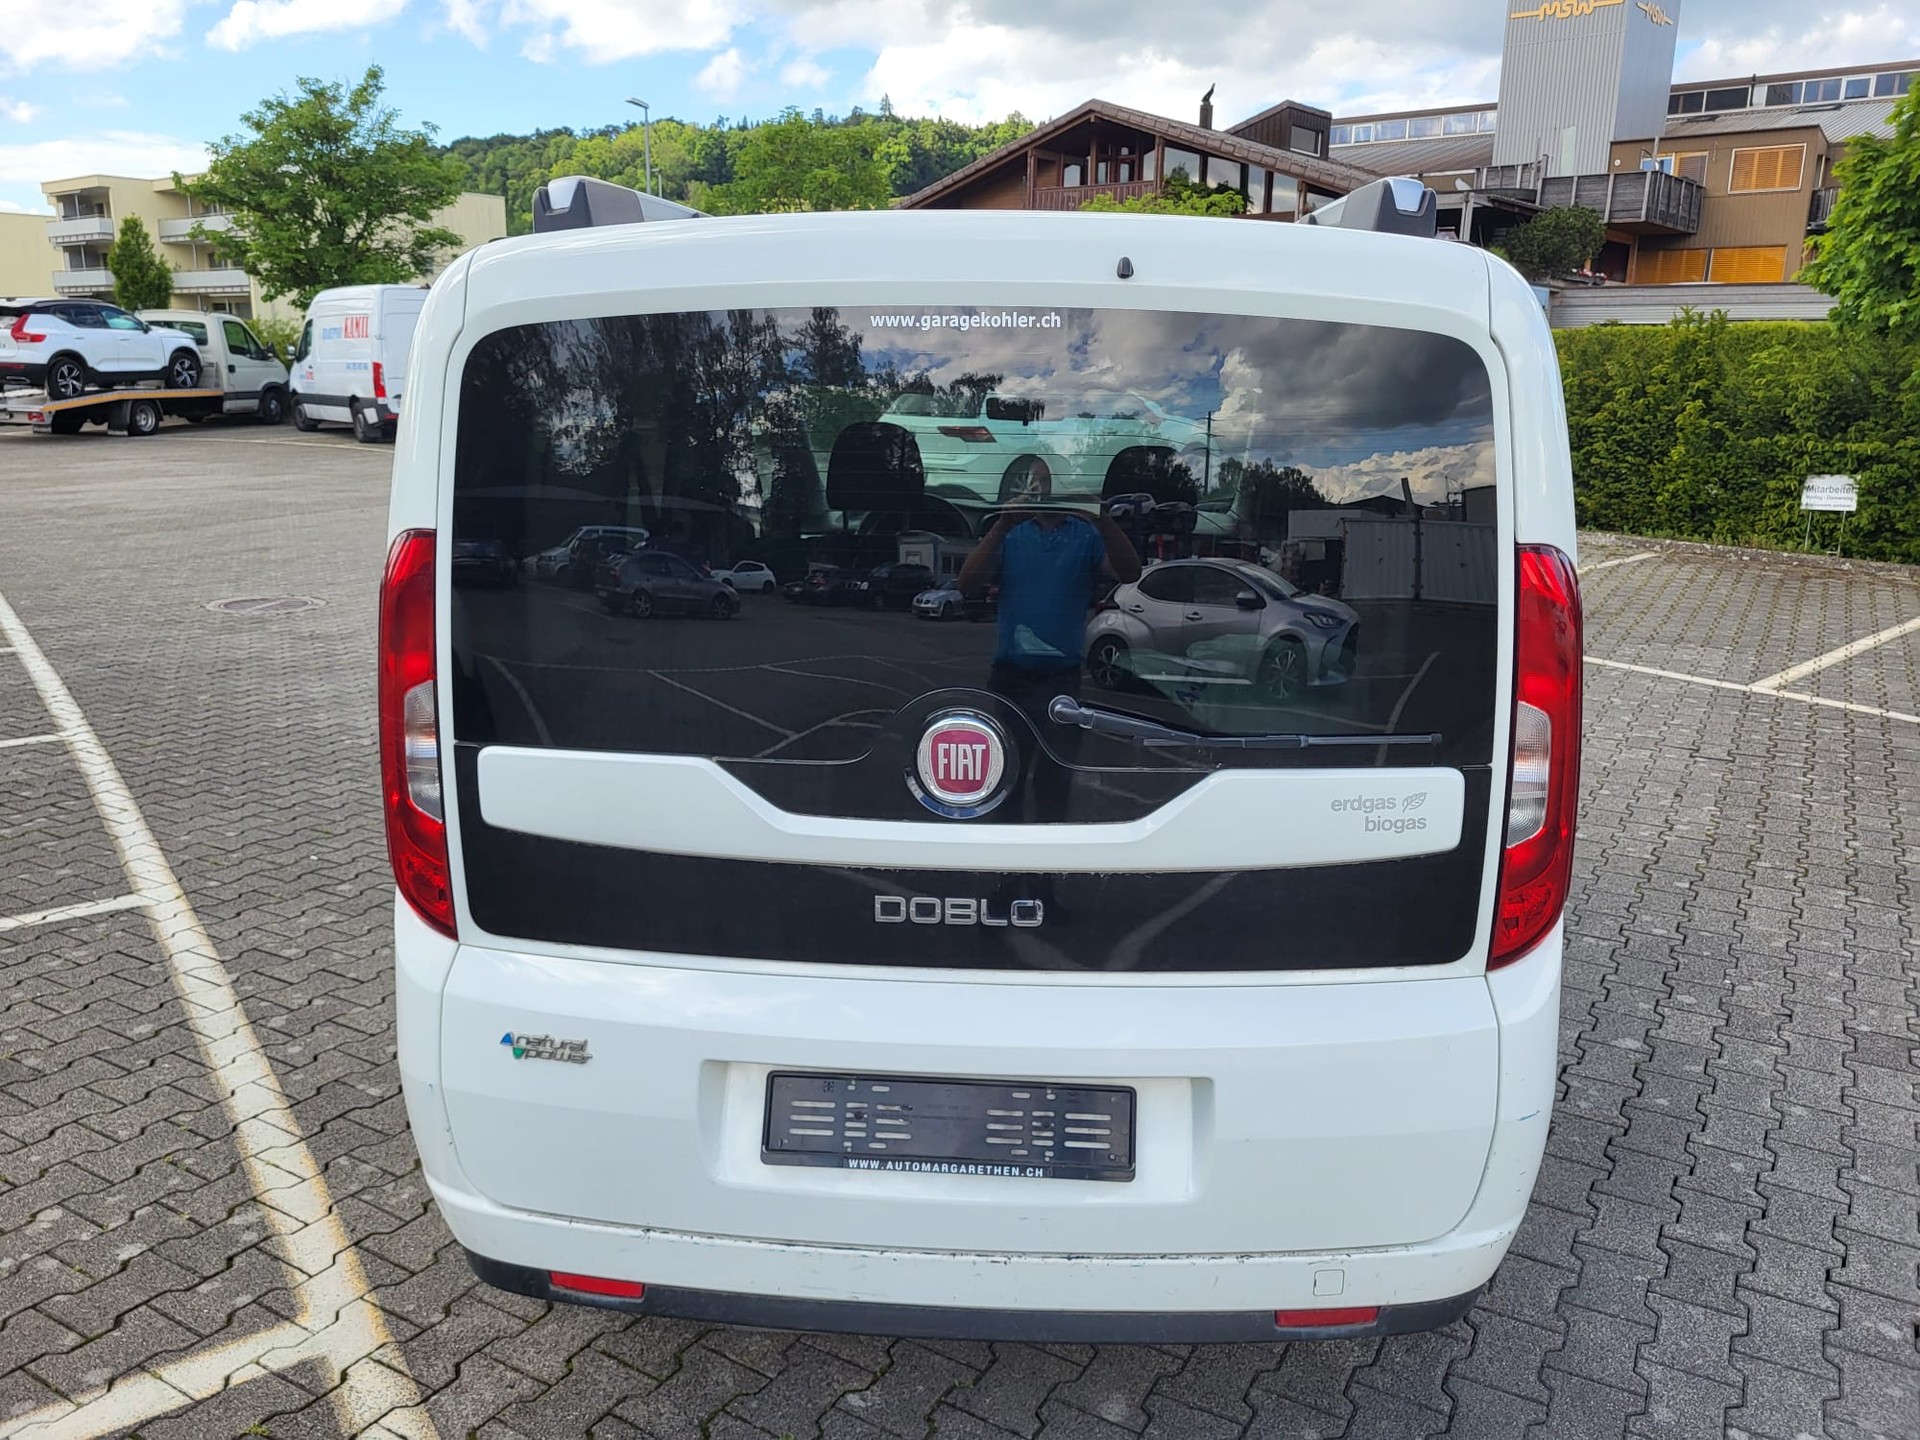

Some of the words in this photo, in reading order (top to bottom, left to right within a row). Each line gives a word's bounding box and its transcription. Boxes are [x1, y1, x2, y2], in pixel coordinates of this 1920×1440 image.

[870, 311, 1061, 330] www.garagekohler.ch
[937, 743, 986, 781] FIAT
[1330, 794, 1397, 814] erdgas
[1364, 815, 1427, 834] biogas
[874, 894, 1044, 927] DOBLO
[515, 1034, 588, 1052] natural
[848, 1158, 1044, 1178] WWW.AUTOMARGARETHEN.CH
